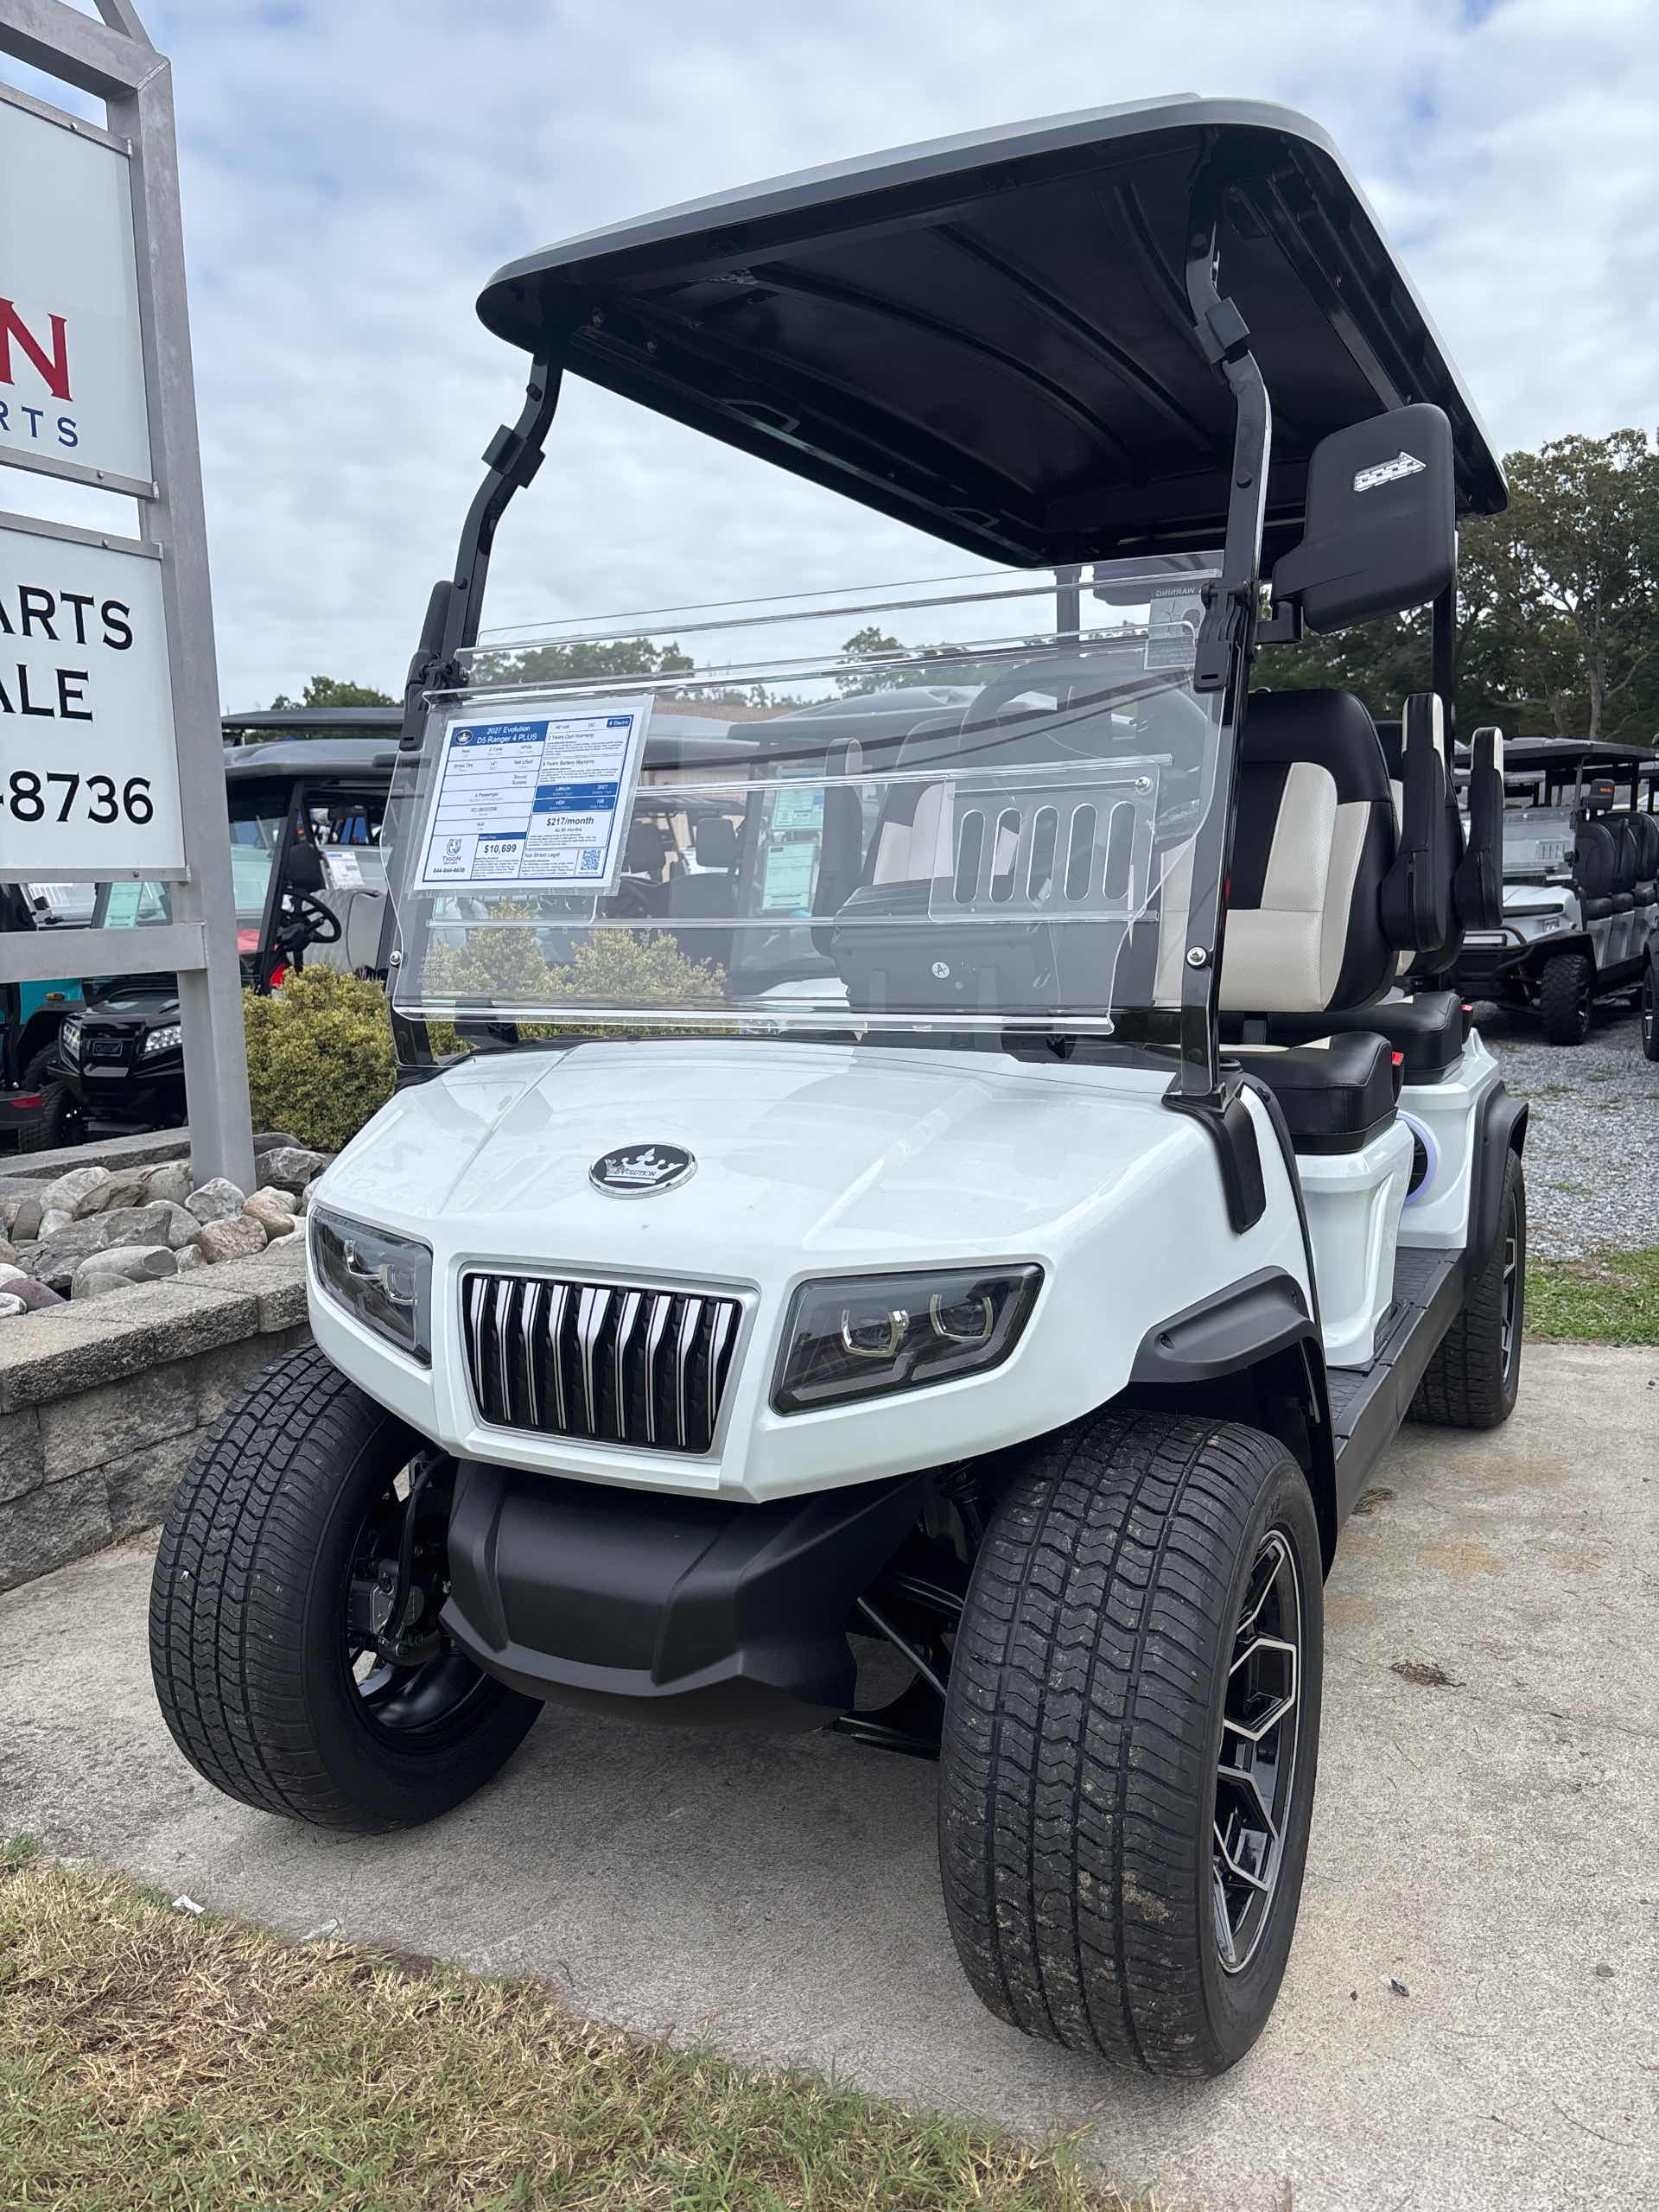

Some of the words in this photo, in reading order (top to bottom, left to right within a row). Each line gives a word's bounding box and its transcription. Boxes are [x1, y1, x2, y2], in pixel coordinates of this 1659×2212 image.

[503, 725, 531, 734] Evolution
[487, 735, 512, 745] Ranger
[0, 770, 154, 825] 8736
[546, 816, 594, 827] $217/month
[483, 844, 517, 855] $10,699
